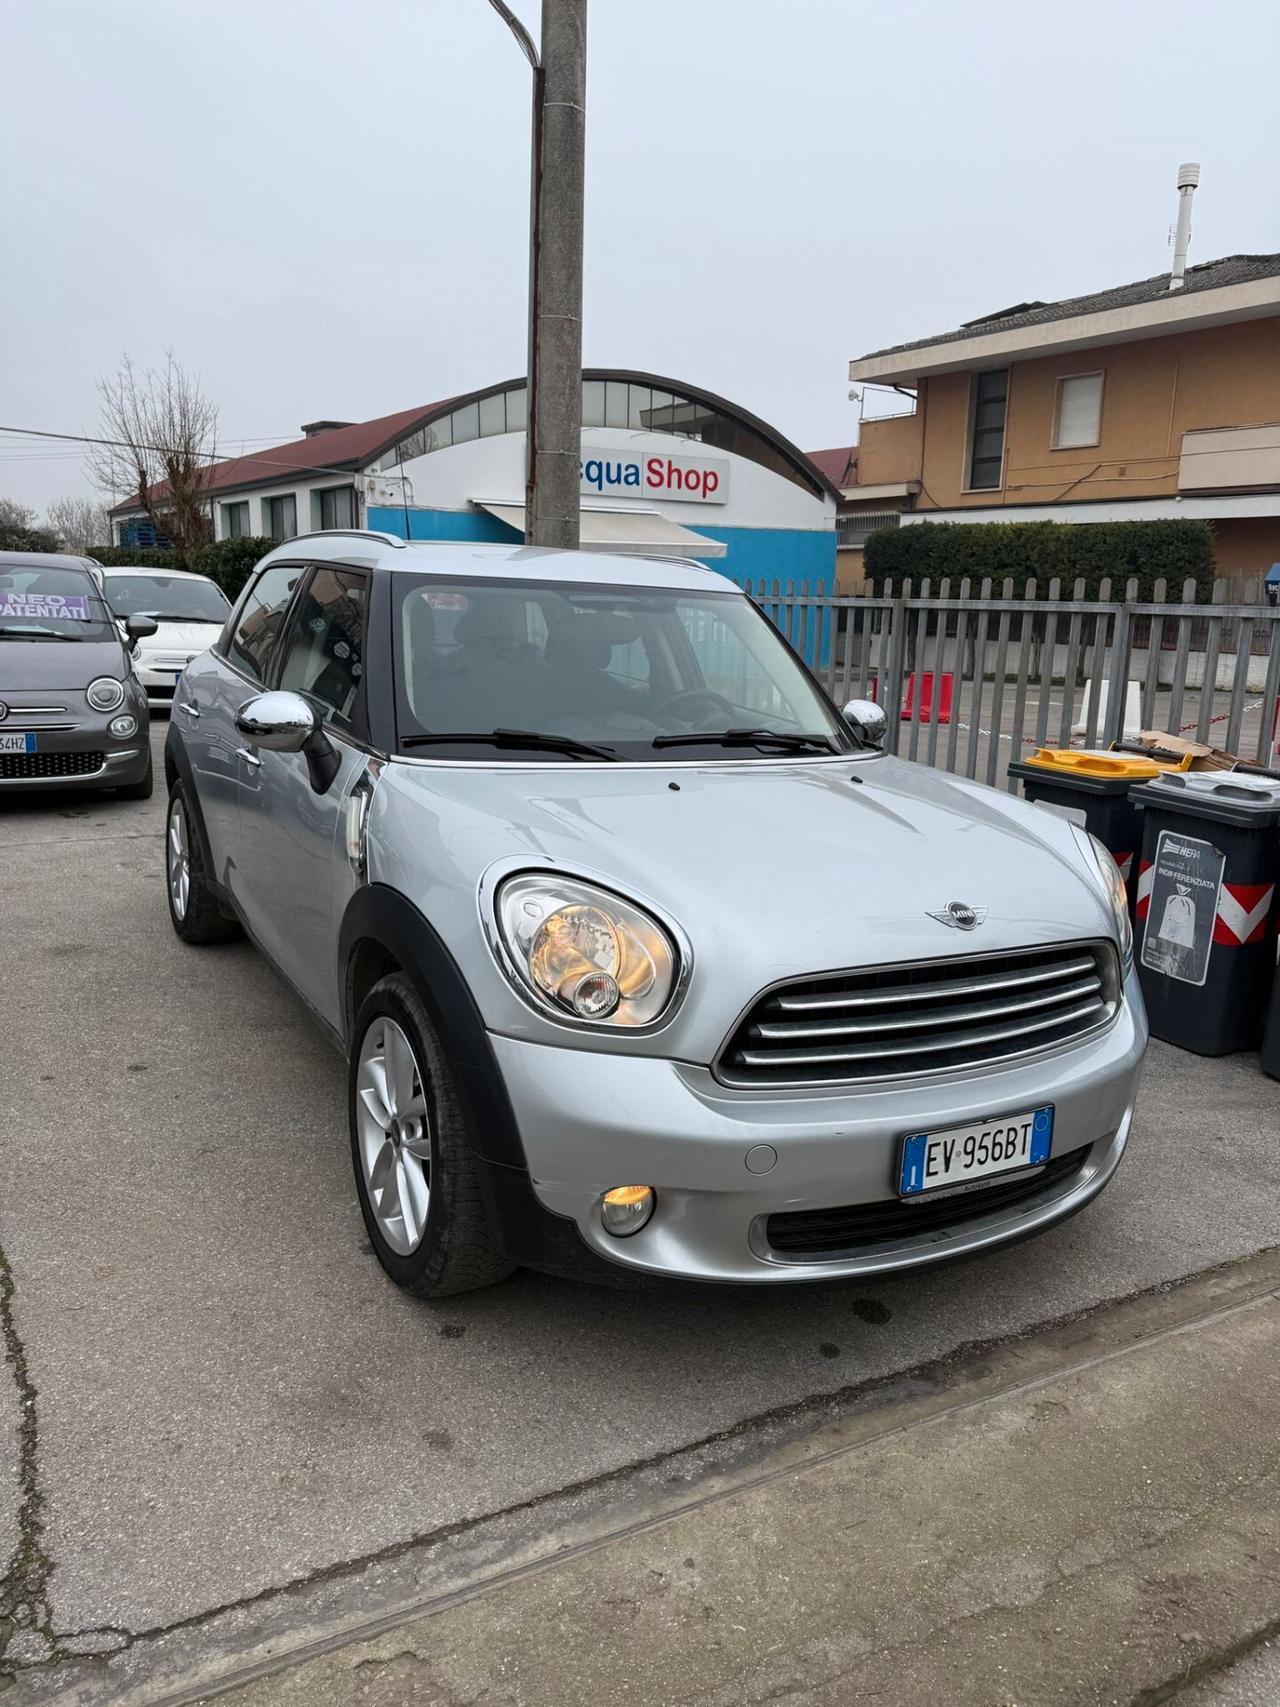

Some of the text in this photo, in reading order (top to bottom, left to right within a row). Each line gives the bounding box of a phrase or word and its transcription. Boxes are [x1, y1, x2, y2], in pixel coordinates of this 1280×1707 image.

[580, 458, 719, 499] qua Shop
[7, 593, 66, 606] NEO
[0, 603, 86, 620] ATENTATI
[1179, 846, 1201, 859] HERA
[952, 909, 975, 919] MINI
